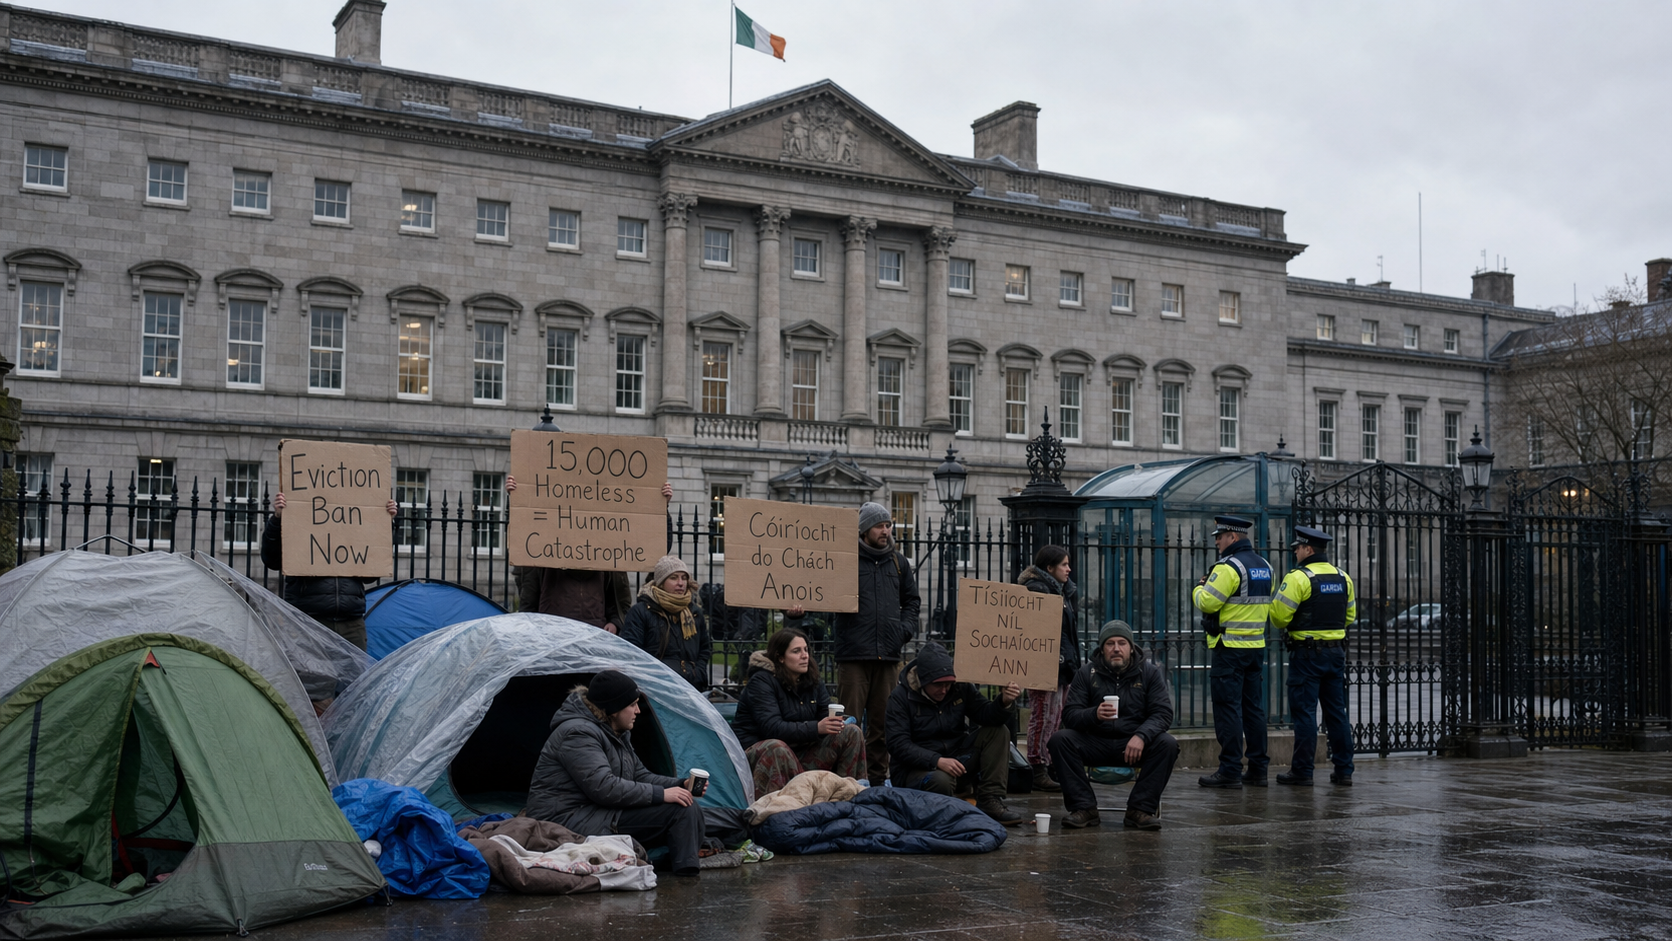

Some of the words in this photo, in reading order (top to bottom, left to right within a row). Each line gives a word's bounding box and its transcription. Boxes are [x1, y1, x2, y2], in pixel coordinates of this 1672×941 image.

[291, 453, 381, 491] Eviction
[546, 439, 648, 479] 15,000
[535, 473, 636, 504] Homeless
[312, 496, 362, 525] Ban
[558, 505, 630, 532] Human
[749, 512, 837, 542] Cóiríocht
[310, 533, 369, 565] Now
[525, 532, 646, 568] Catastrophe
[751, 544, 773, 567] do
[782, 547, 834, 571] Chách
[760, 572, 824, 602] Anois
[997, 611, 1023, 630] NÍL
[988, 655, 1028, 676] ANN
